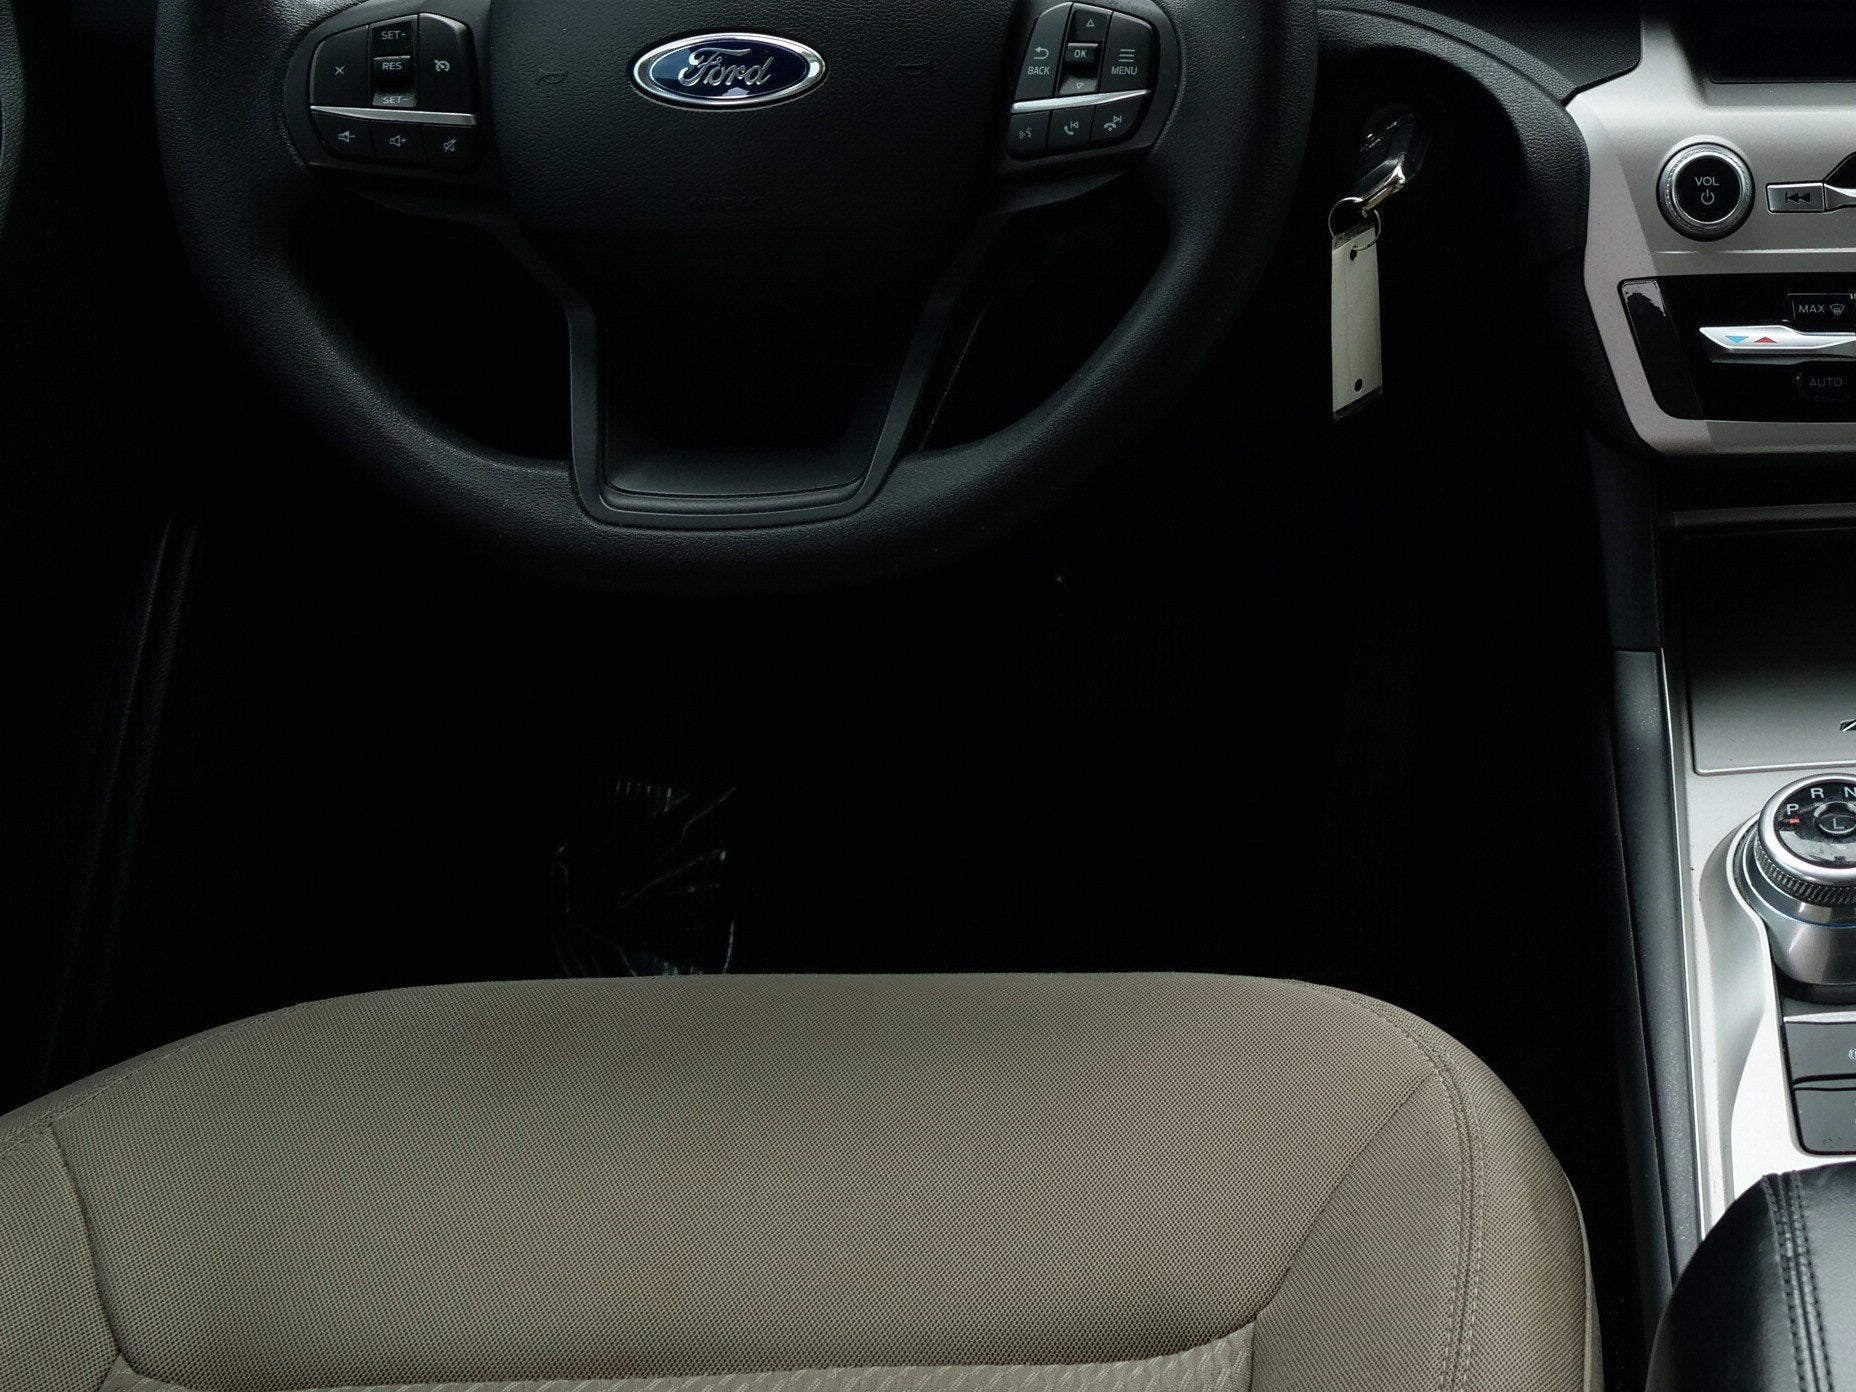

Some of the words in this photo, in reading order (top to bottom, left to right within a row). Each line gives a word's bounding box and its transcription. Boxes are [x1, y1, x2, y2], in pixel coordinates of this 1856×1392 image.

[1073, 48, 1087, 59] OK
[382, 60, 402, 71] RES
[678, 46, 773, 87] Ford
[1027, 65, 1050, 76] BACK
[1111, 65, 1138, 76] MENU
[1694, 175, 1720, 187] VOL
[1798, 304, 1826, 314] MAX
[1809, 376, 1843, 388] AUTO
[1786, 802, 1799, 815] P
[1810, 786, 1824, 799] R
[1832, 817, 1845, 830] L
